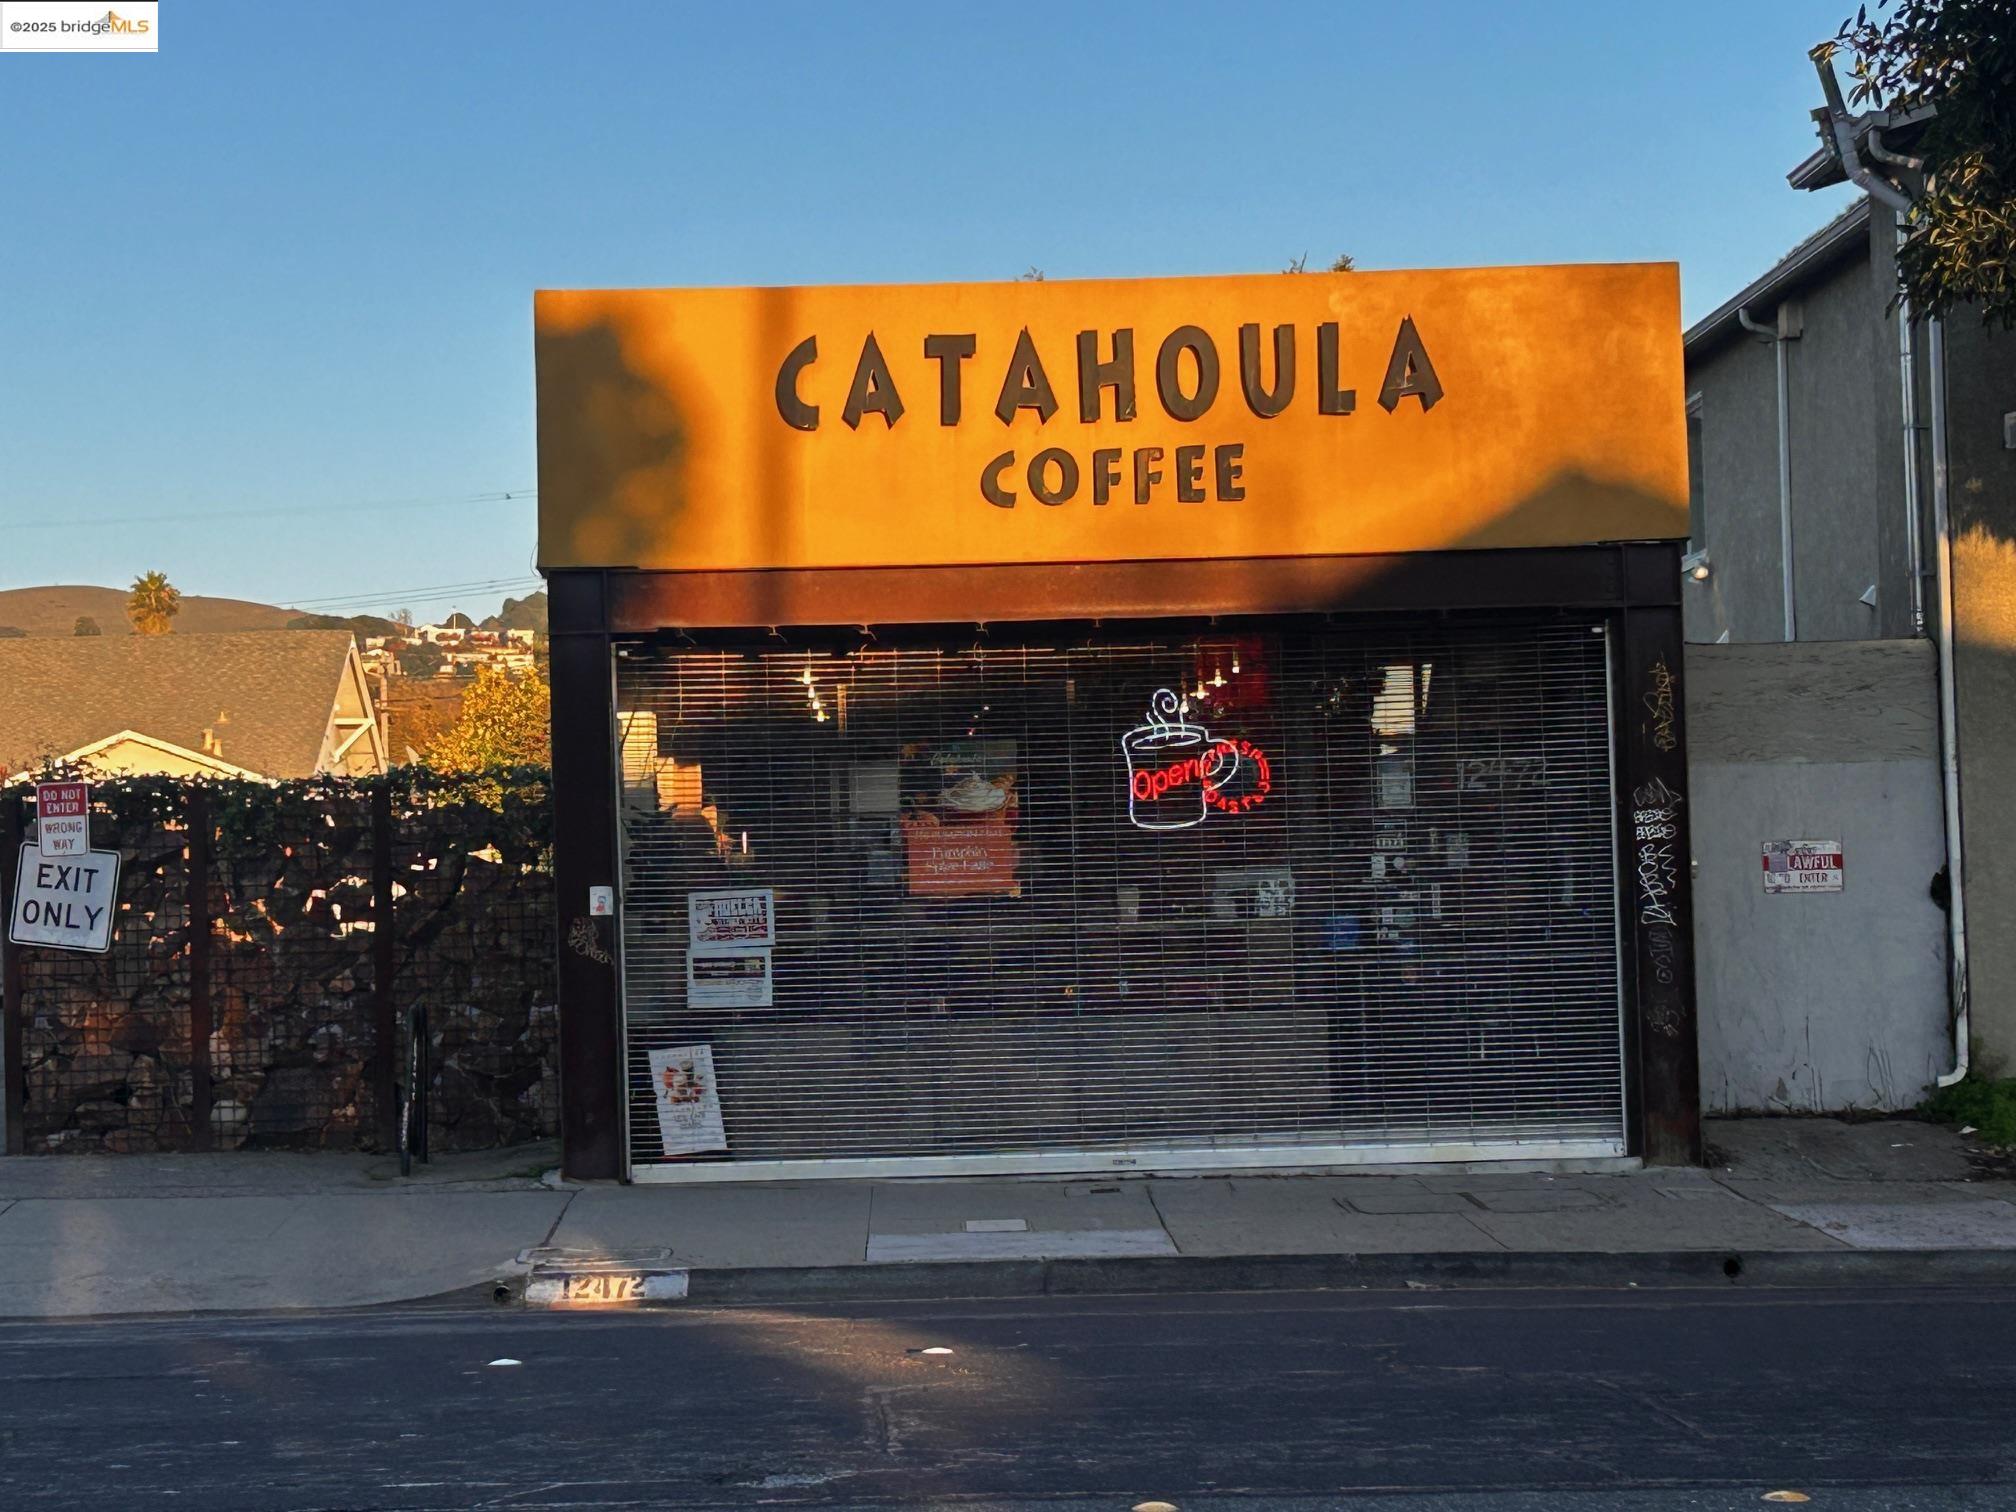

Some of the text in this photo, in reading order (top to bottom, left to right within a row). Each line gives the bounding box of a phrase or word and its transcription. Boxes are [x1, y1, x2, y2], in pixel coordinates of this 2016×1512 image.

[775, 313, 1445, 432] CATAHOULA
[980, 442, 1247, 509] COFFEE
[1133, 758, 1202, 801] Open
[42, 788, 81, 801] DO NOT
[46, 801, 79, 814] ENTER
[45, 821, 82, 834] WRONG
[53, 838, 74, 851] WAY
[37, 863, 99, 893] EXIT
[23, 899, 104, 931] ONLY
[563, 1274, 646, 1299] 12472
